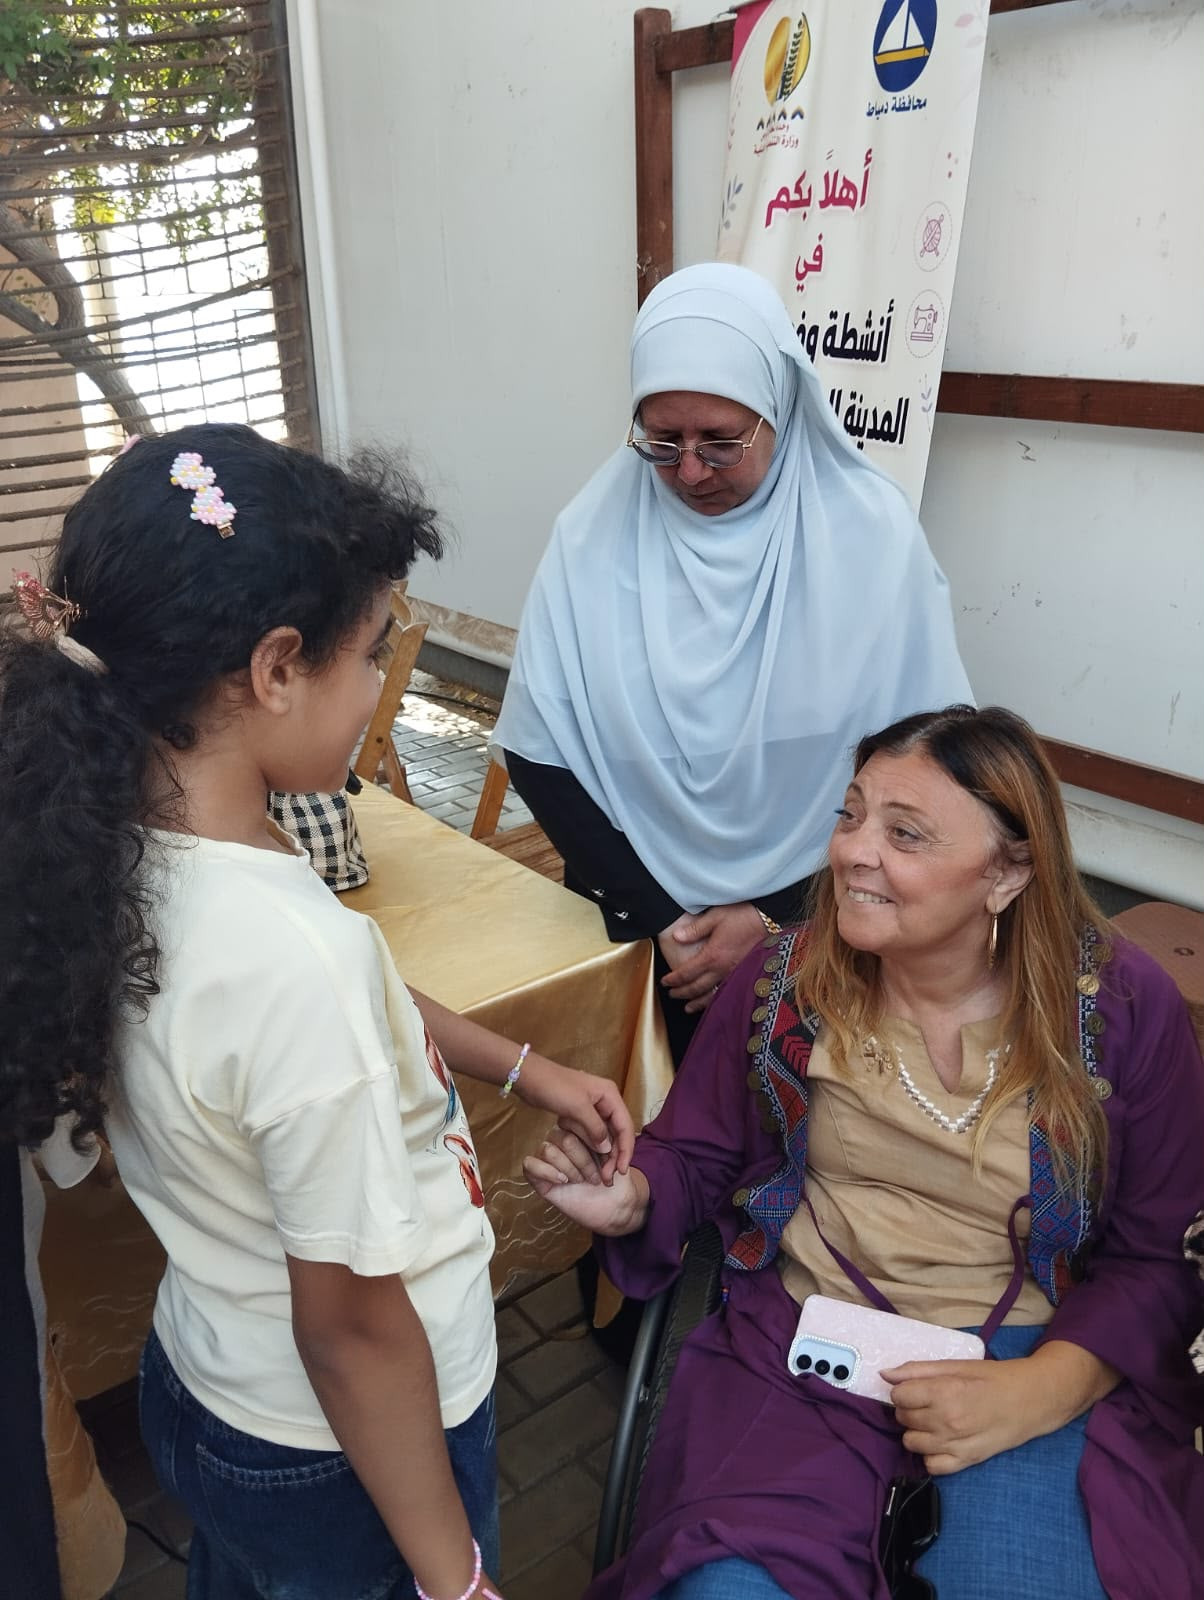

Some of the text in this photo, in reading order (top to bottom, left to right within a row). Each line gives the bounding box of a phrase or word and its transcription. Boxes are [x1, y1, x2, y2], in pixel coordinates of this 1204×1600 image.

[866, 95, 928, 121] محافظة دمياط
[764, 169, 812, 229] بكم
[795, 232, 823, 292] في
[822, 299, 895, 363] أنشطة
[843, 393, 909, 451] المدينة
